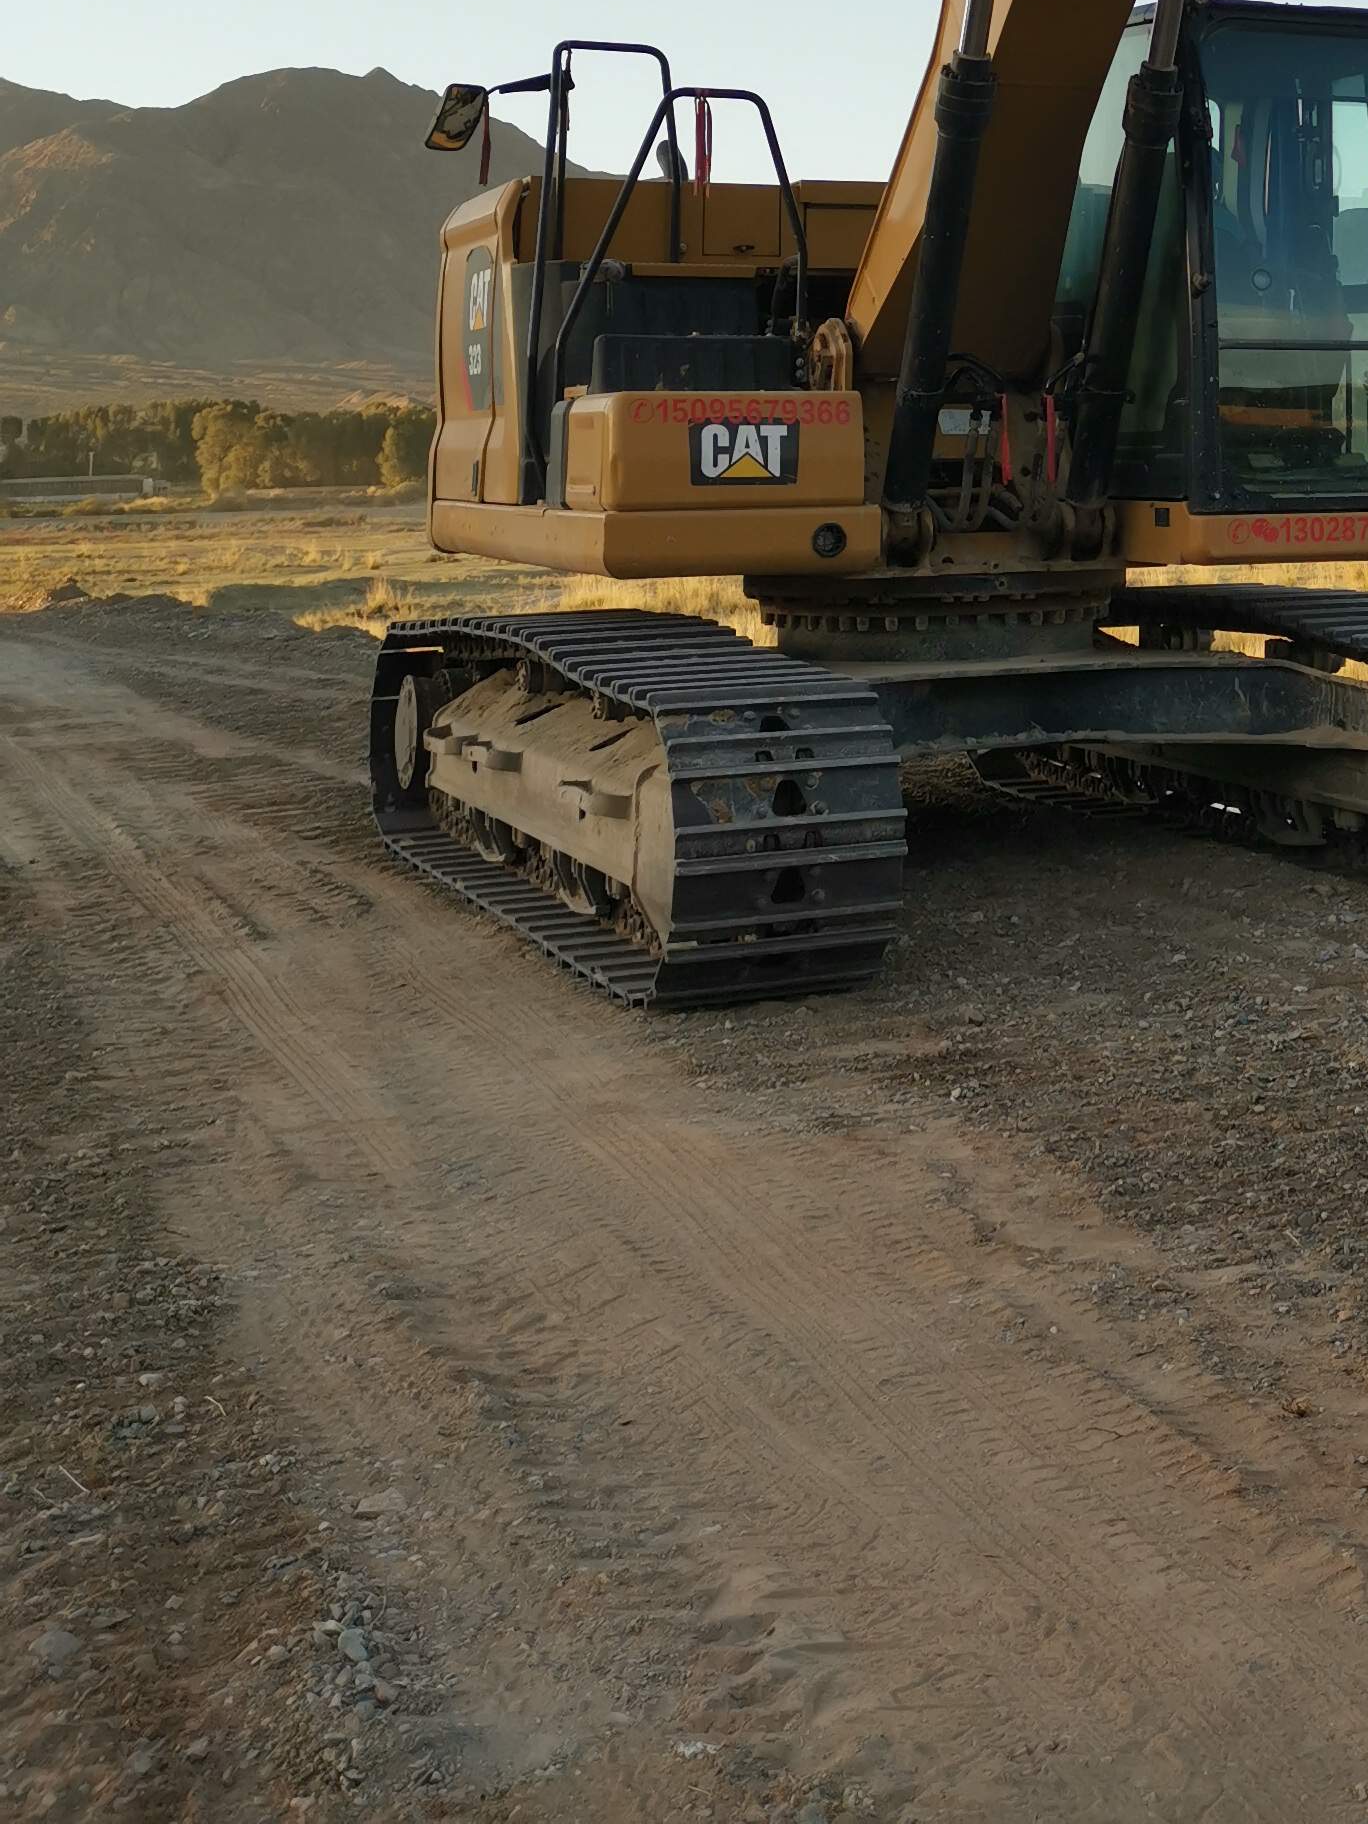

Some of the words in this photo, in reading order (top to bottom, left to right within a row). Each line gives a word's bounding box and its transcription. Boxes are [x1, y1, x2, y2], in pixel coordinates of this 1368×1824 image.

[469, 268, 492, 331] CAT
[468, 343, 482, 376] 323
[655, 398, 851, 425] 15095679366
[700, 424, 788, 478] CAT
